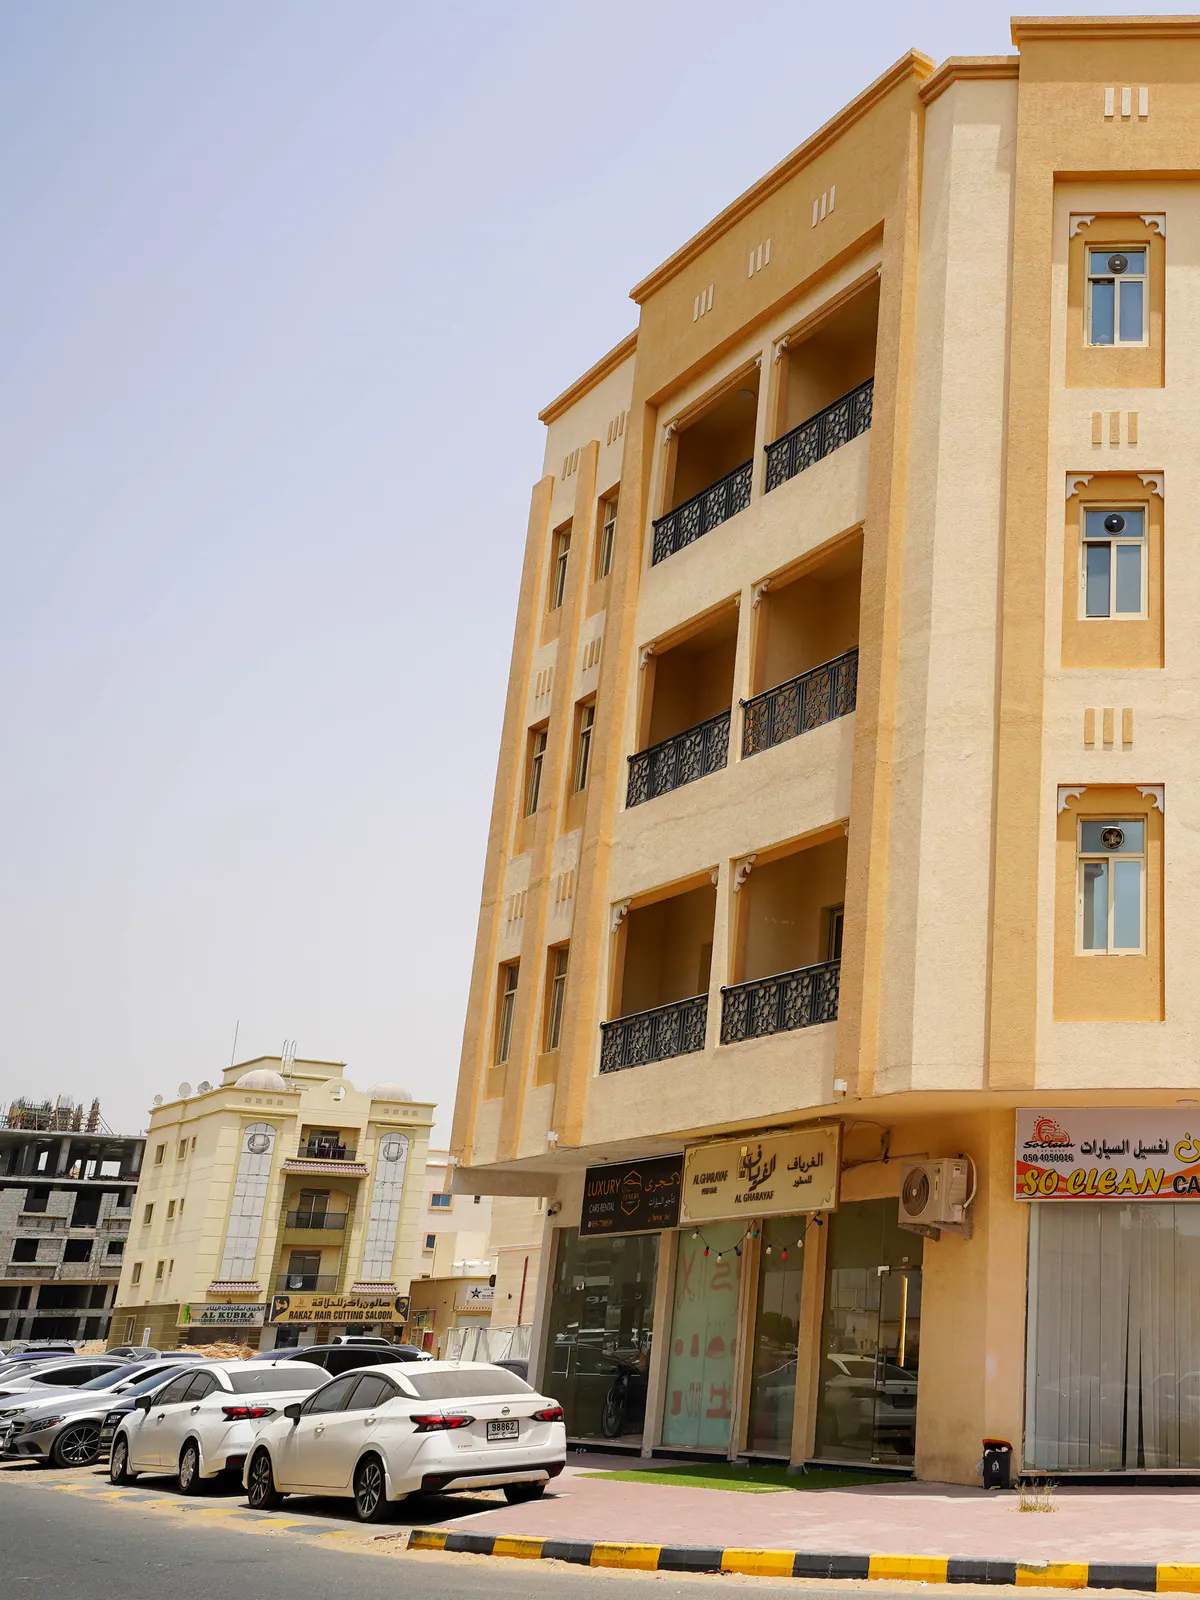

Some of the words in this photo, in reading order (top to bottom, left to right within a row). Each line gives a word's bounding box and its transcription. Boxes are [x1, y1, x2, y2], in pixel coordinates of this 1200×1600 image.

[1080, 1138, 1130, 1160] السيارات
[1133, 1138, 1169, 1160] لغسيل
[787, 1152, 823, 1173] الغرياف
[1023, 1153, 1039, 1162] 050
[1039, 1153, 1075, 1162] 4050016
[693, 1174, 700, 1185] AL
[700, 1170, 728, 1185] GHARAYAF
[793, 1174, 813, 1188] للعطور
[1022, 1167, 1059, 1195] SO
[1066, 1167, 1165, 1195] CLEAN
[587, 1179, 621, 1197] LUXURY
[734, 1194, 742, 1204] AL
[743, 1191, 775, 1203] GHARAYAF
[589, 1203, 600, 1213] CARS
[600, 1202, 615, 1212] RENTAL
[312, 1297, 343, 1308] للحلاقة
[364, 1297, 391, 1308] صالون
[288, 1310, 312, 1320] RAKAZ
[314, 1310, 331, 1320] HAIR
[333, 1310, 363, 1320] CUTTING
[365, 1310, 392, 1320] SALOON
[491, 1422, 515, 1432] 98862
